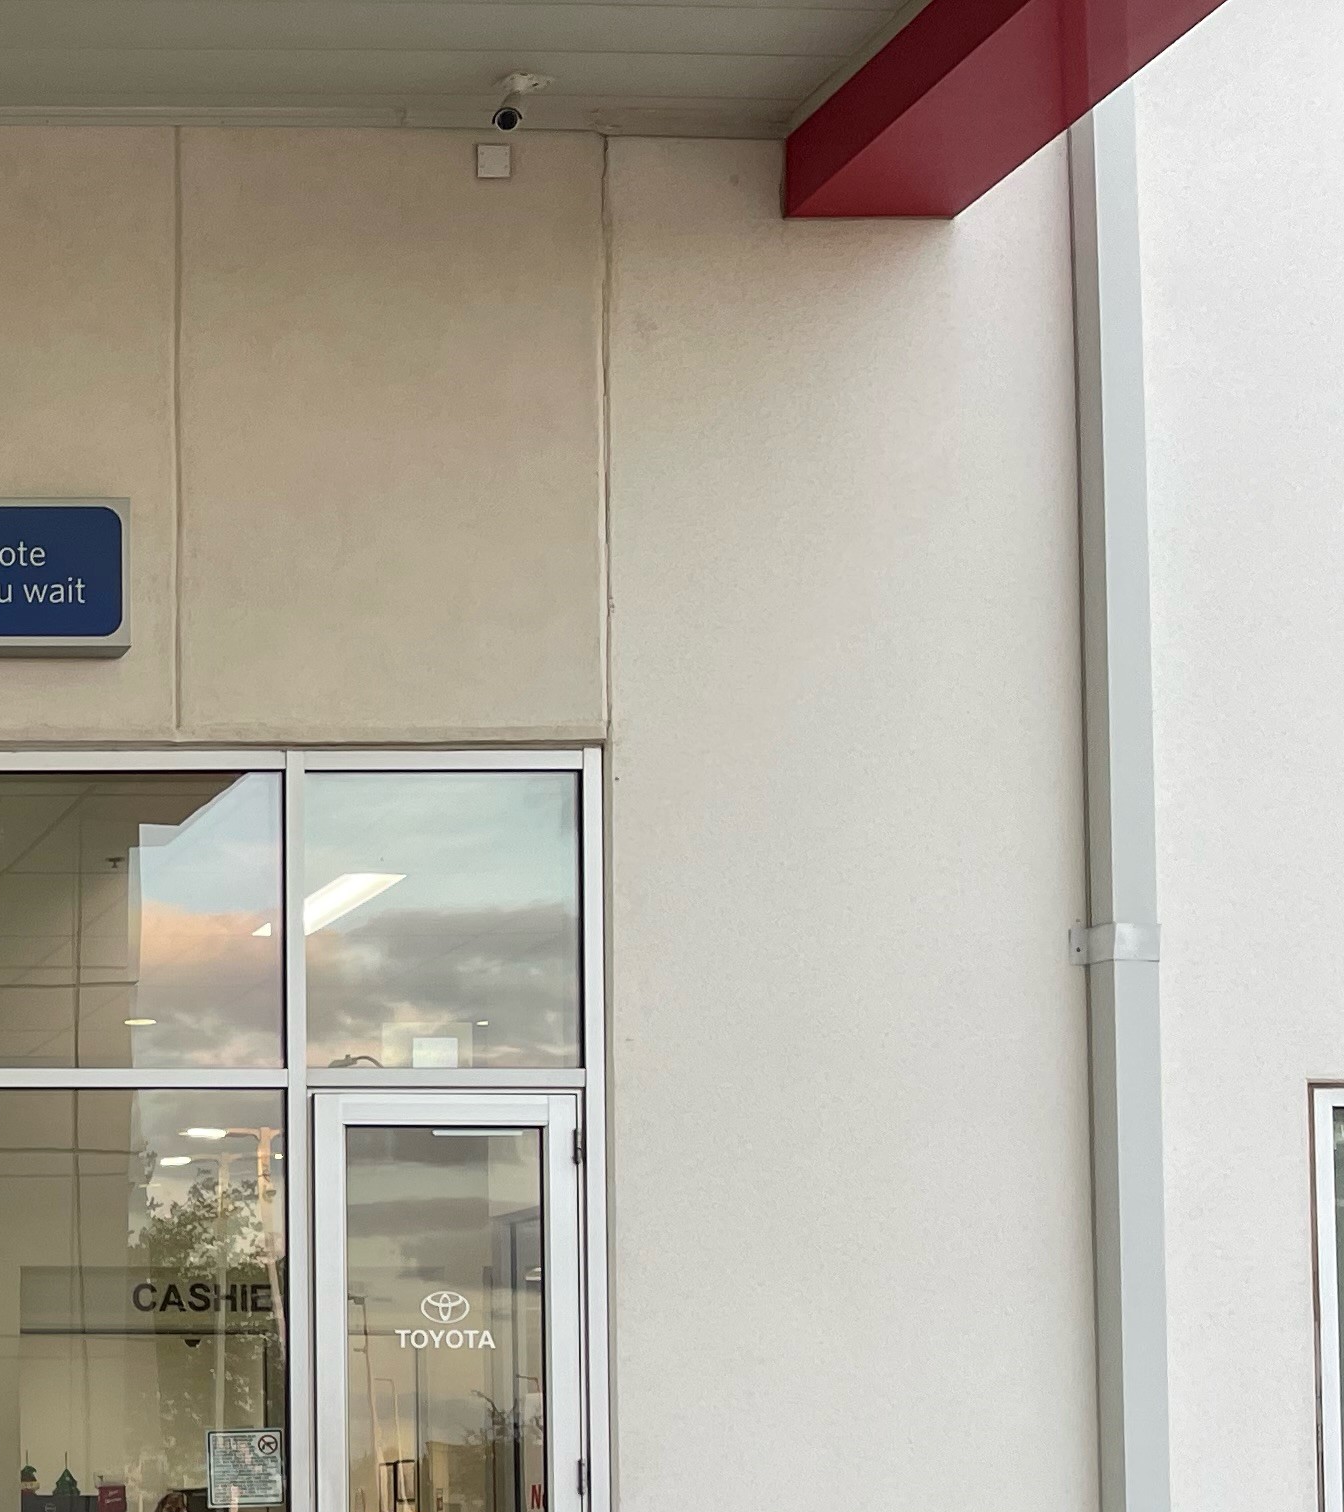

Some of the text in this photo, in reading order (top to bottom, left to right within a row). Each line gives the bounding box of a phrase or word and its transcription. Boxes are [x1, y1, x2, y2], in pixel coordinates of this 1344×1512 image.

[23, 576, 86, 604] wait
[132, 1283, 273, 1312] CASHIE
[394, 1329, 496, 1349] TOYOTA
